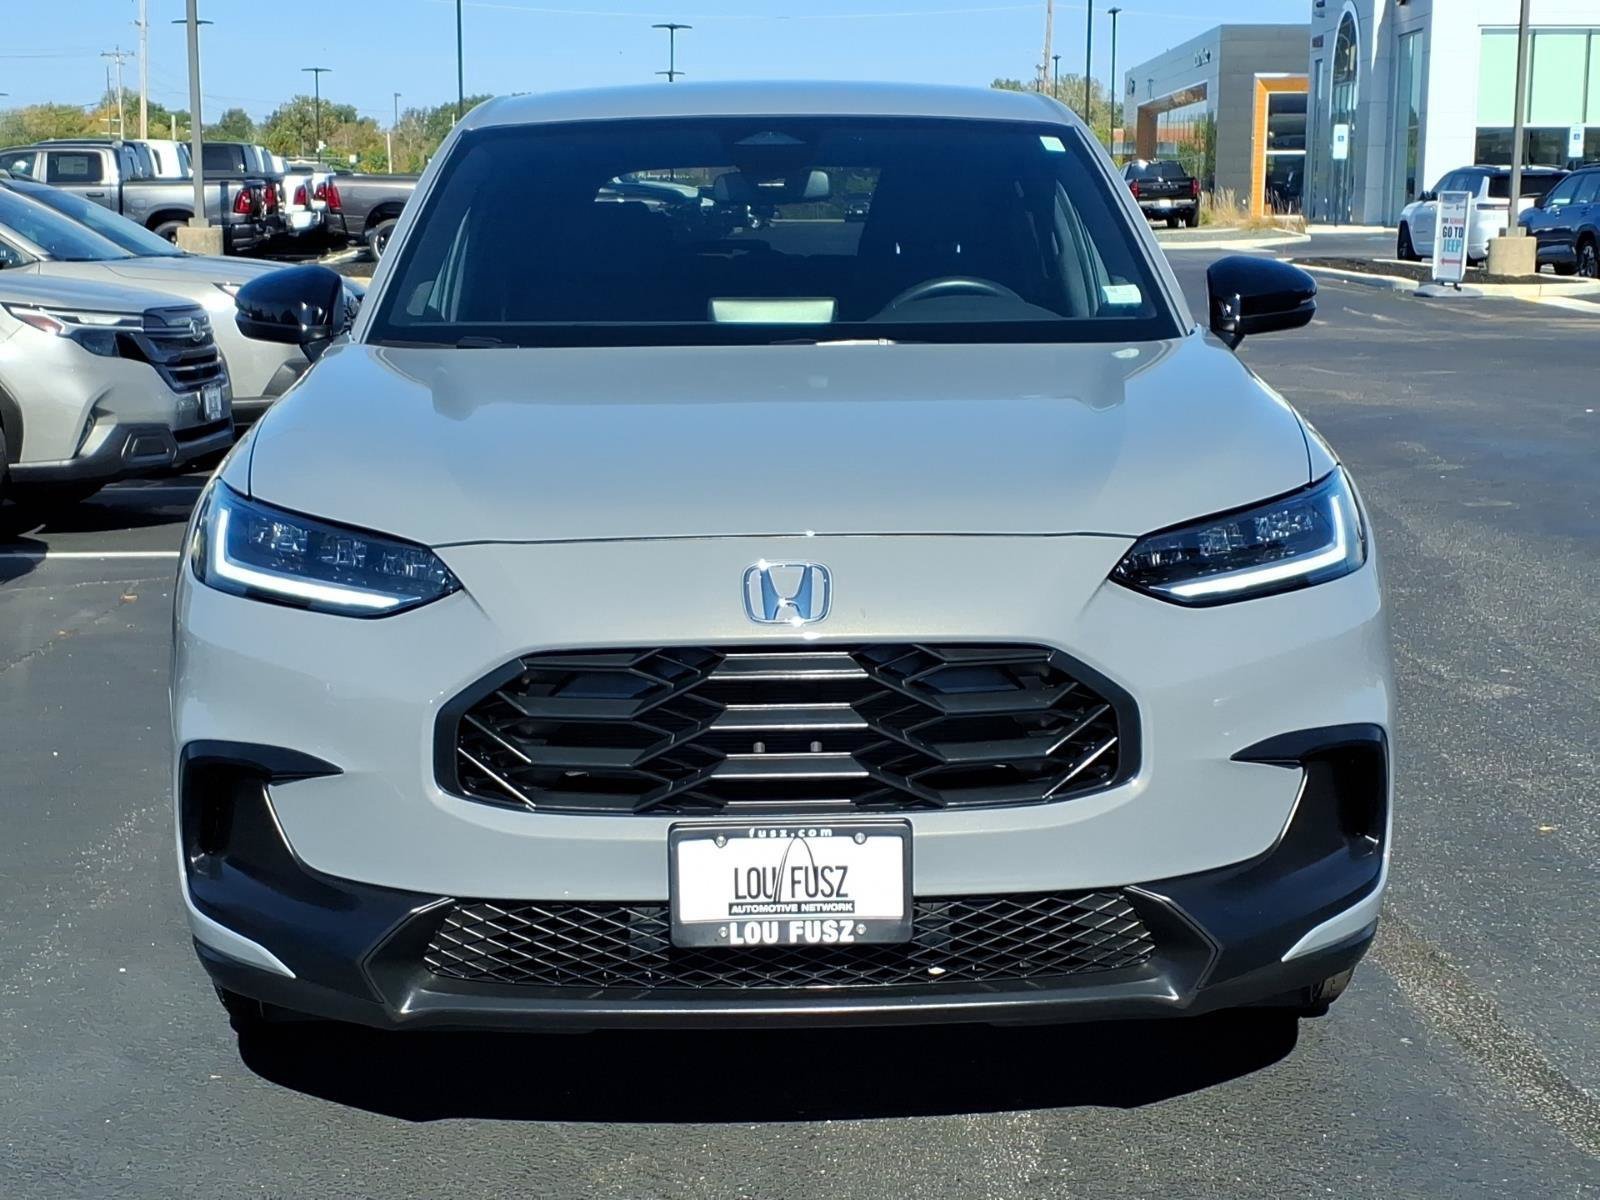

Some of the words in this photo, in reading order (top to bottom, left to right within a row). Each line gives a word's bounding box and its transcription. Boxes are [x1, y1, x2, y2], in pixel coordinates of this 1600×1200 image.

[1442, 226, 1453, 238] GO
[748, 828, 833, 838] fusz.com
[734, 866, 776, 900] LOU
[790, 865, 849, 898] FUSZ
[731, 903, 799, 914] AUTOMOTIVE
[801, 902, 854, 912] NETWORK
[729, 921, 779, 944] LOU
[789, 920, 855, 943] FUSZ
